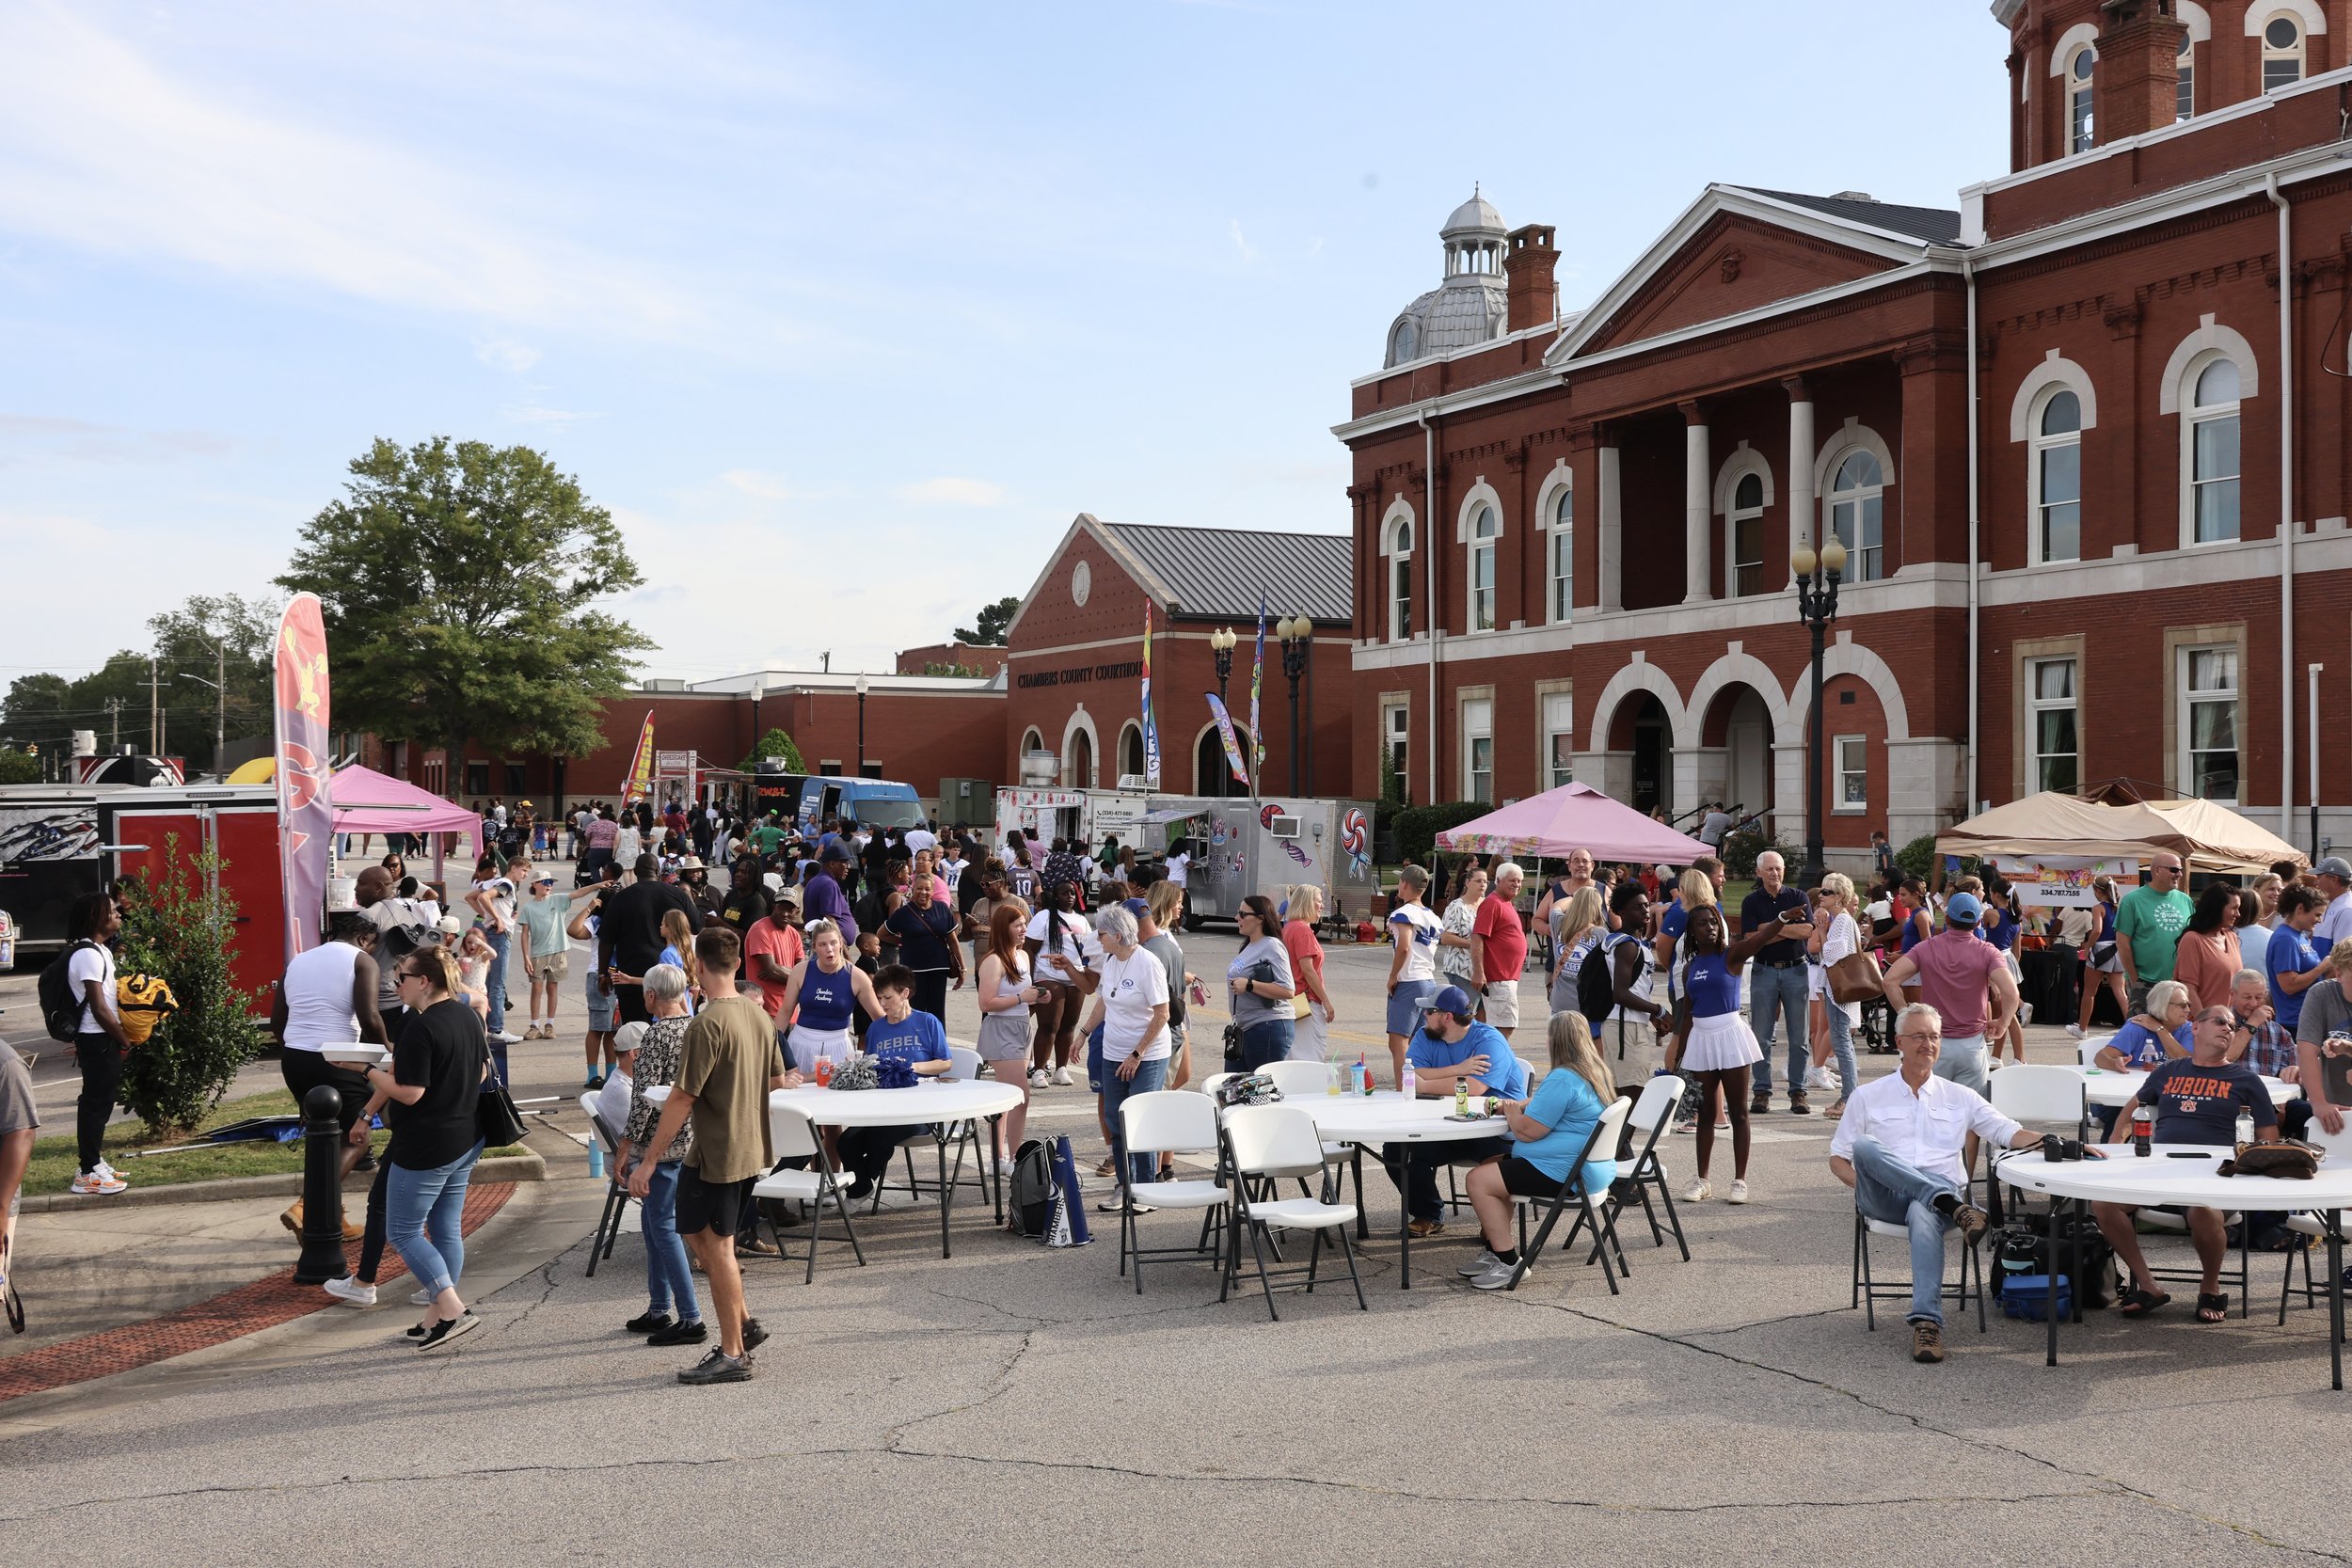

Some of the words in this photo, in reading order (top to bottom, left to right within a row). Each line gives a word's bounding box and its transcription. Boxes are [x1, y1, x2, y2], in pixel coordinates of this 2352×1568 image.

[1018, 670, 1058, 689] CHAMBERS
[1060, 667, 1094, 684] COUNTY
[1095, 661, 1143, 681] COURTHOU
[1209, 854, 1227, 863] MOBILE
[1016, 879, 1032, 896] 10
[876, 1035, 923, 1054] REBEL
[2162, 1076, 2233, 1100] AUBURN
[1048, 1196, 1065, 1245] CHAMBERS
